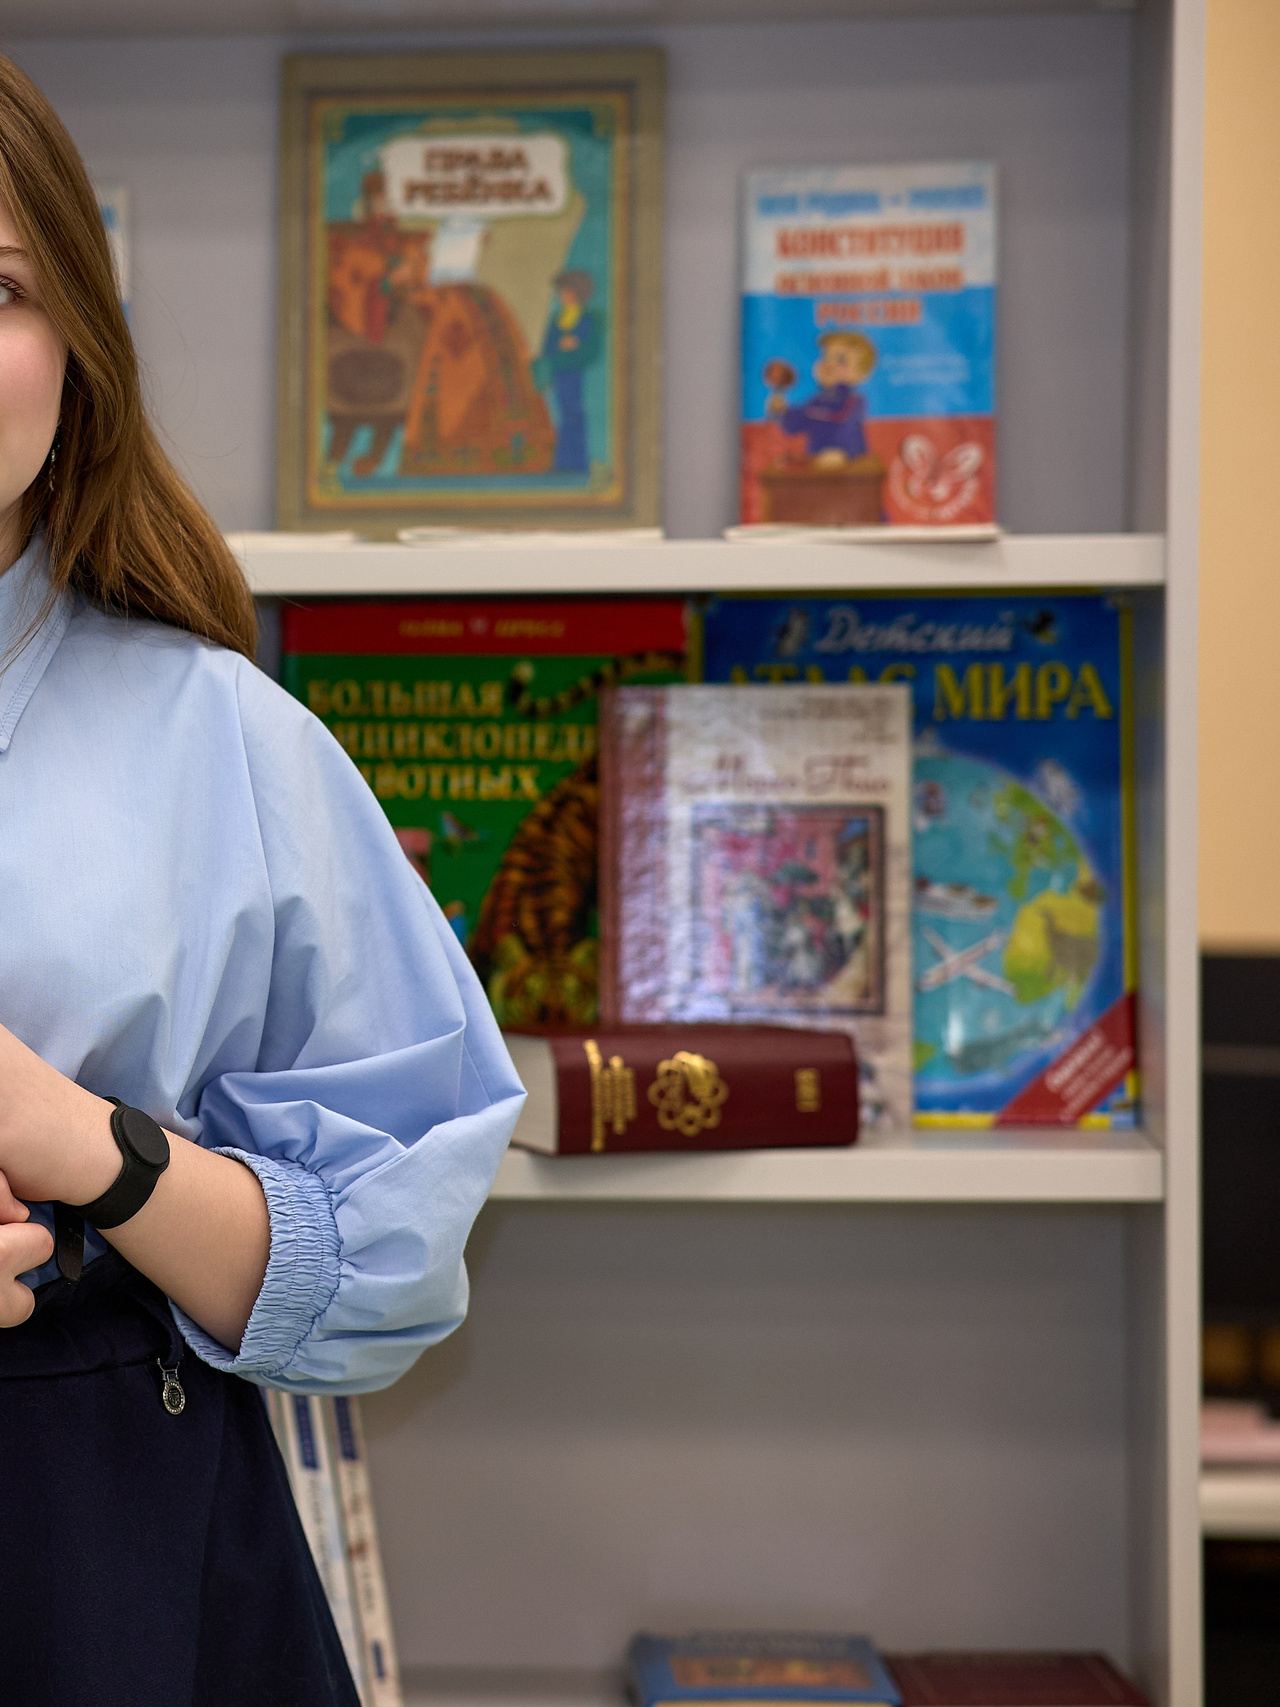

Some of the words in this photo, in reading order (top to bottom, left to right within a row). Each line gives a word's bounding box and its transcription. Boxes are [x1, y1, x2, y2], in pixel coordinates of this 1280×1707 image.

[423, 147, 531, 173] ПРАВА
[816, 607, 1016, 653] Детский
[307, 679, 503, 716] БОЛЬШАЯ
[934, 662, 1112, 721] МИРА
